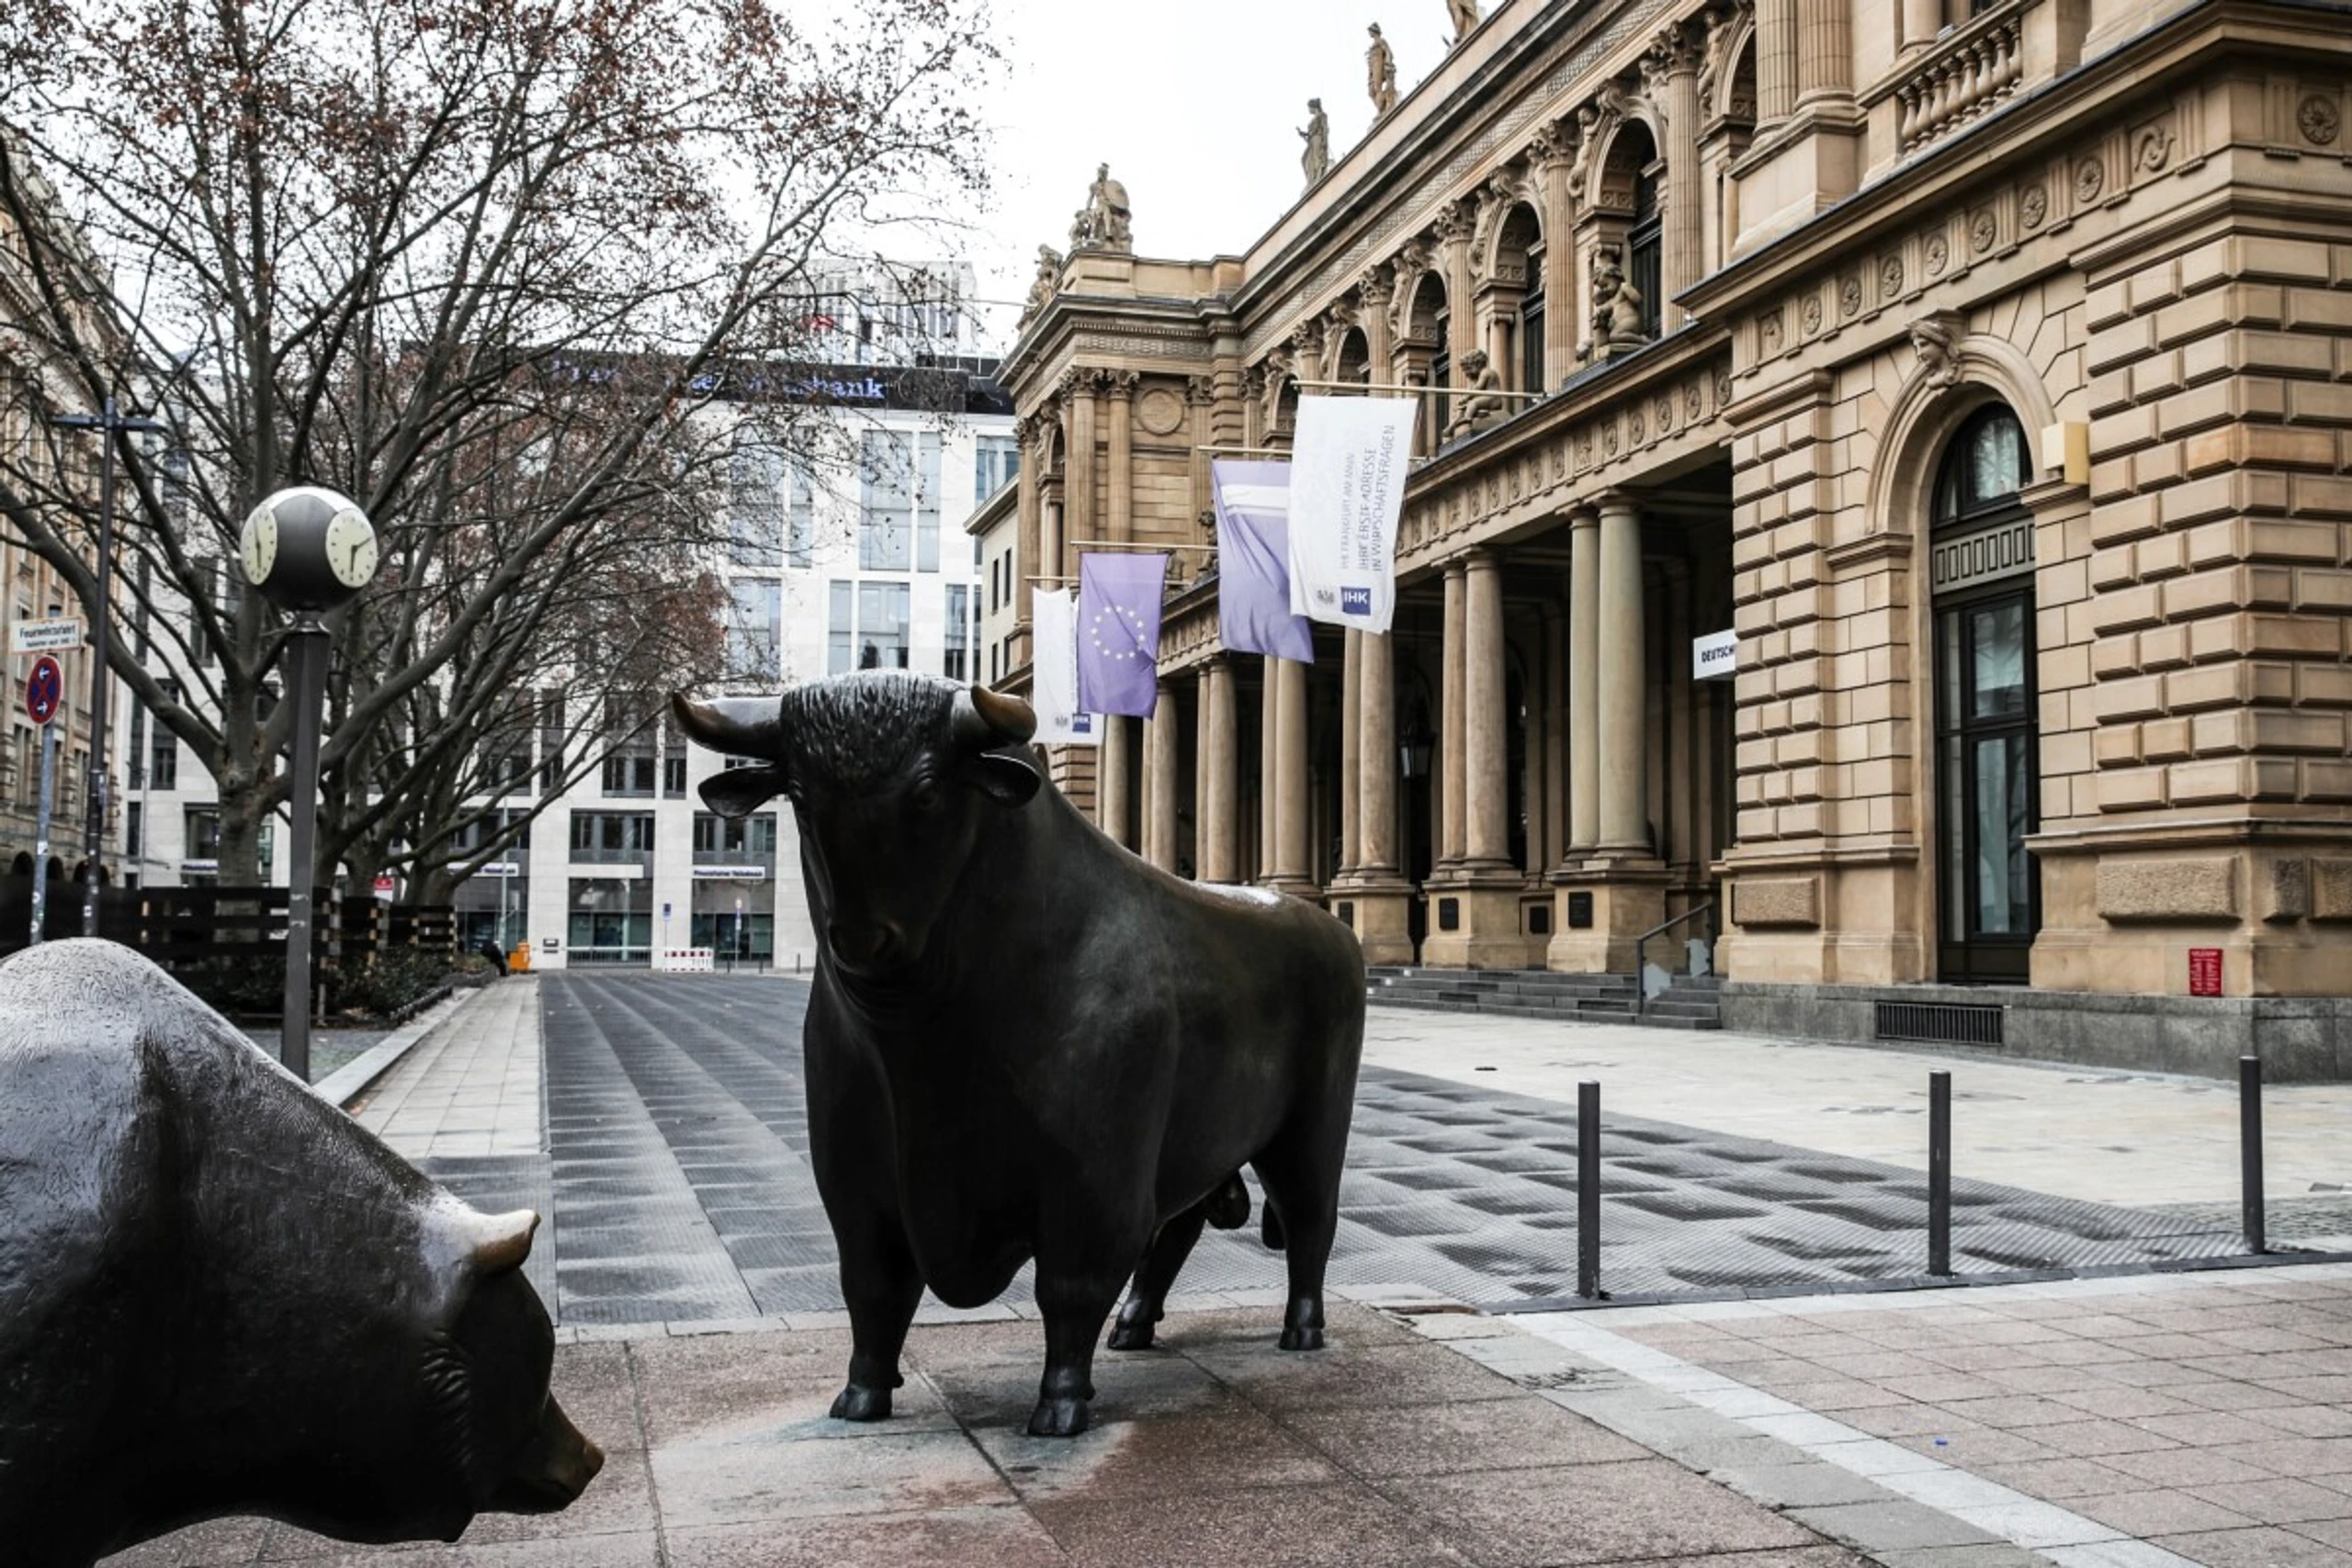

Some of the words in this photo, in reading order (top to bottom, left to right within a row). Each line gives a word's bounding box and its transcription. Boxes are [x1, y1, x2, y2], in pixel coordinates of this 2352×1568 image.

[1359, 447, 1376, 502] ADRESSE
[1372, 559, 1383, 572] IN
[1344, 591, 1368, 605] IHK
